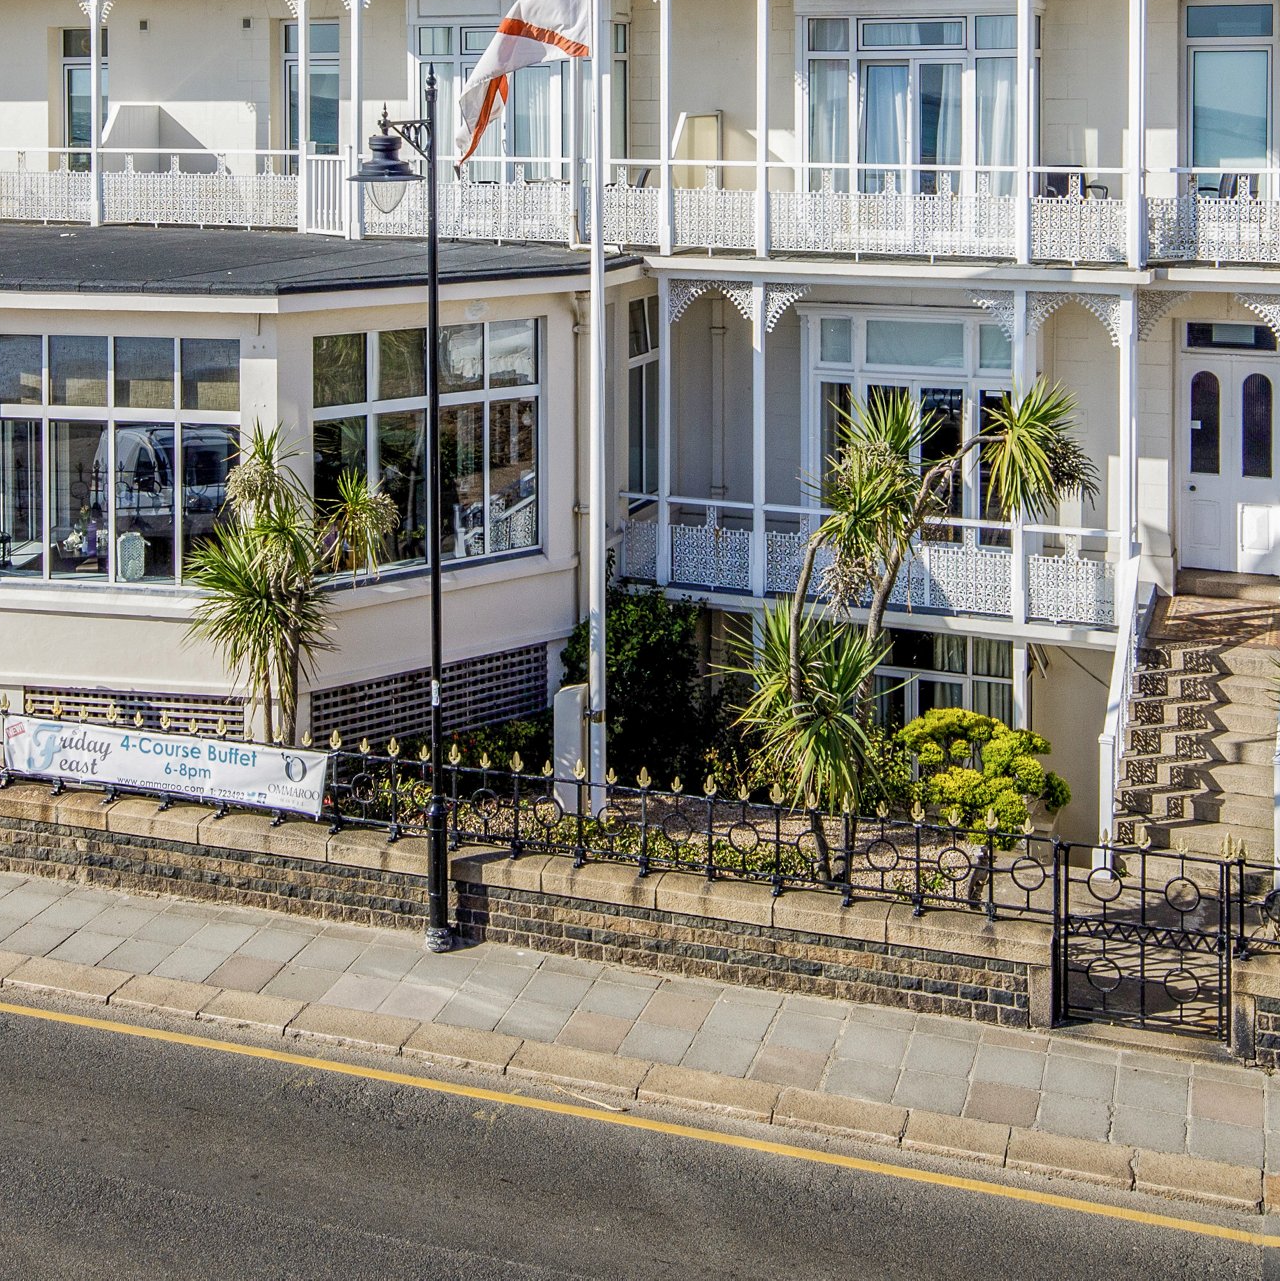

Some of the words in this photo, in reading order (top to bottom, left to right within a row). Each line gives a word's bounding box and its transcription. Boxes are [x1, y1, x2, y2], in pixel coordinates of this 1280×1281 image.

[120, 735, 201, 759] 4-Course
[208, 744, 257, 767] Buffet
[164, 762, 211, 780] 6-8pm
[117, 777, 205, 794] www.ommaroo.com
[267, 783, 320, 801] OMMAROO
